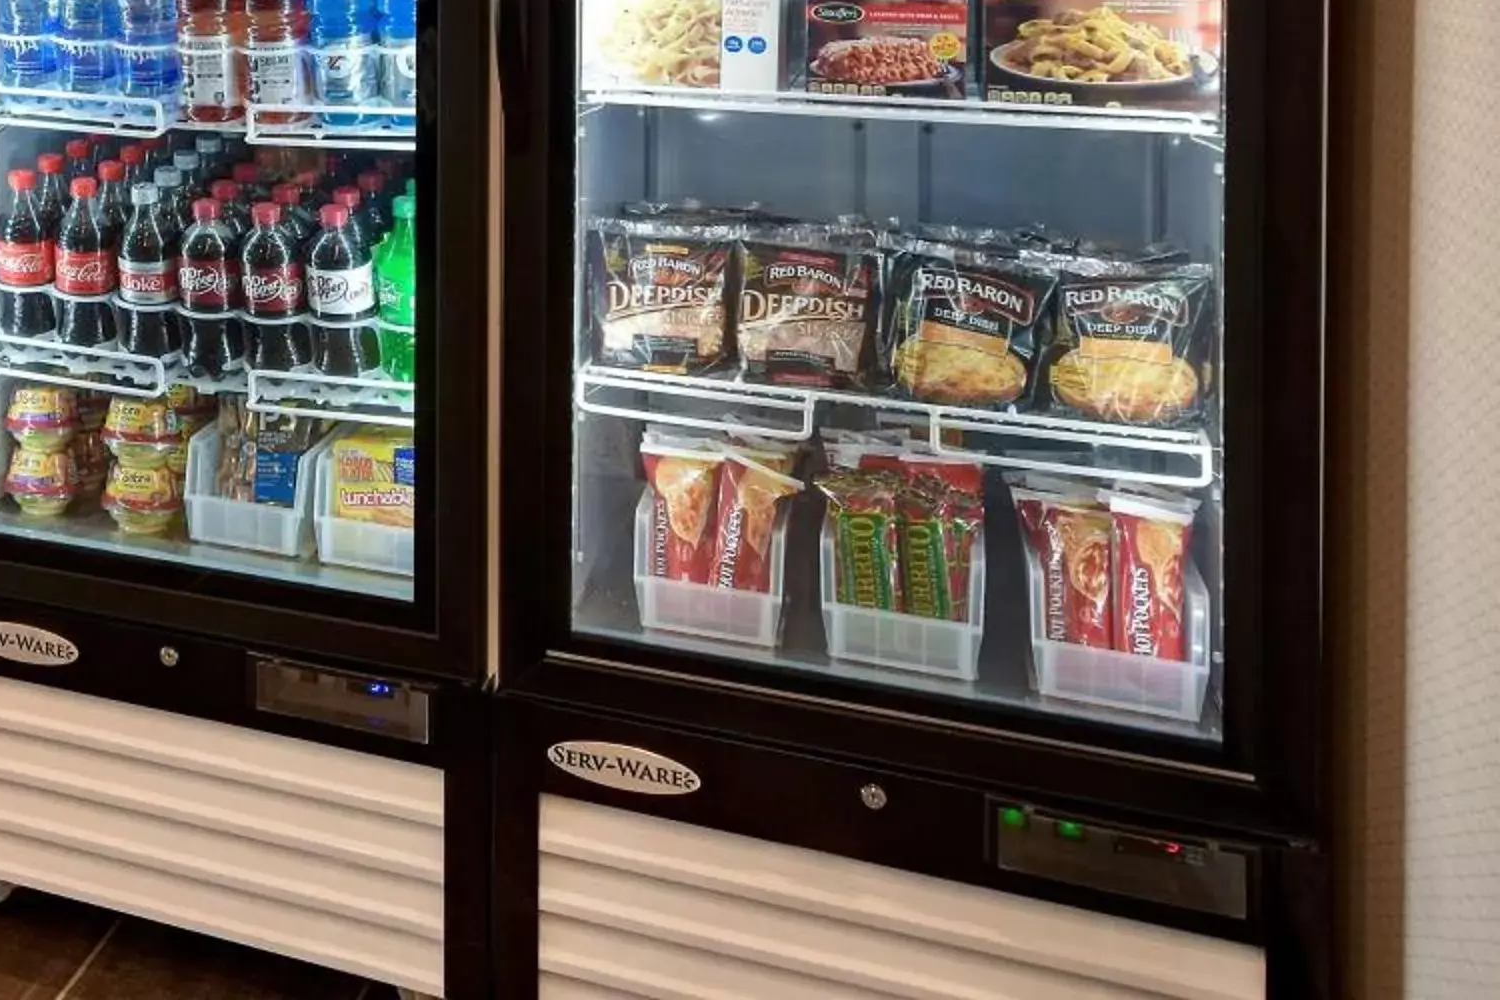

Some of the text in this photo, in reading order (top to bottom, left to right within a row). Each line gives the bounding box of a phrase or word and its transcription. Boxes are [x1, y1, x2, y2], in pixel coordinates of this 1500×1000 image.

[633, 258, 700, 275] RED BARON
[769, 265, 844, 289] RED BARON
[921, 271, 1026, 314] RED BARON
[1065, 285, 1181, 316] RED BARON
[933, 306, 966, 322] DEEP
[1086, 321, 1159, 336] DEEP DISH
[553, 745, 685, 788] SERV-WARE
